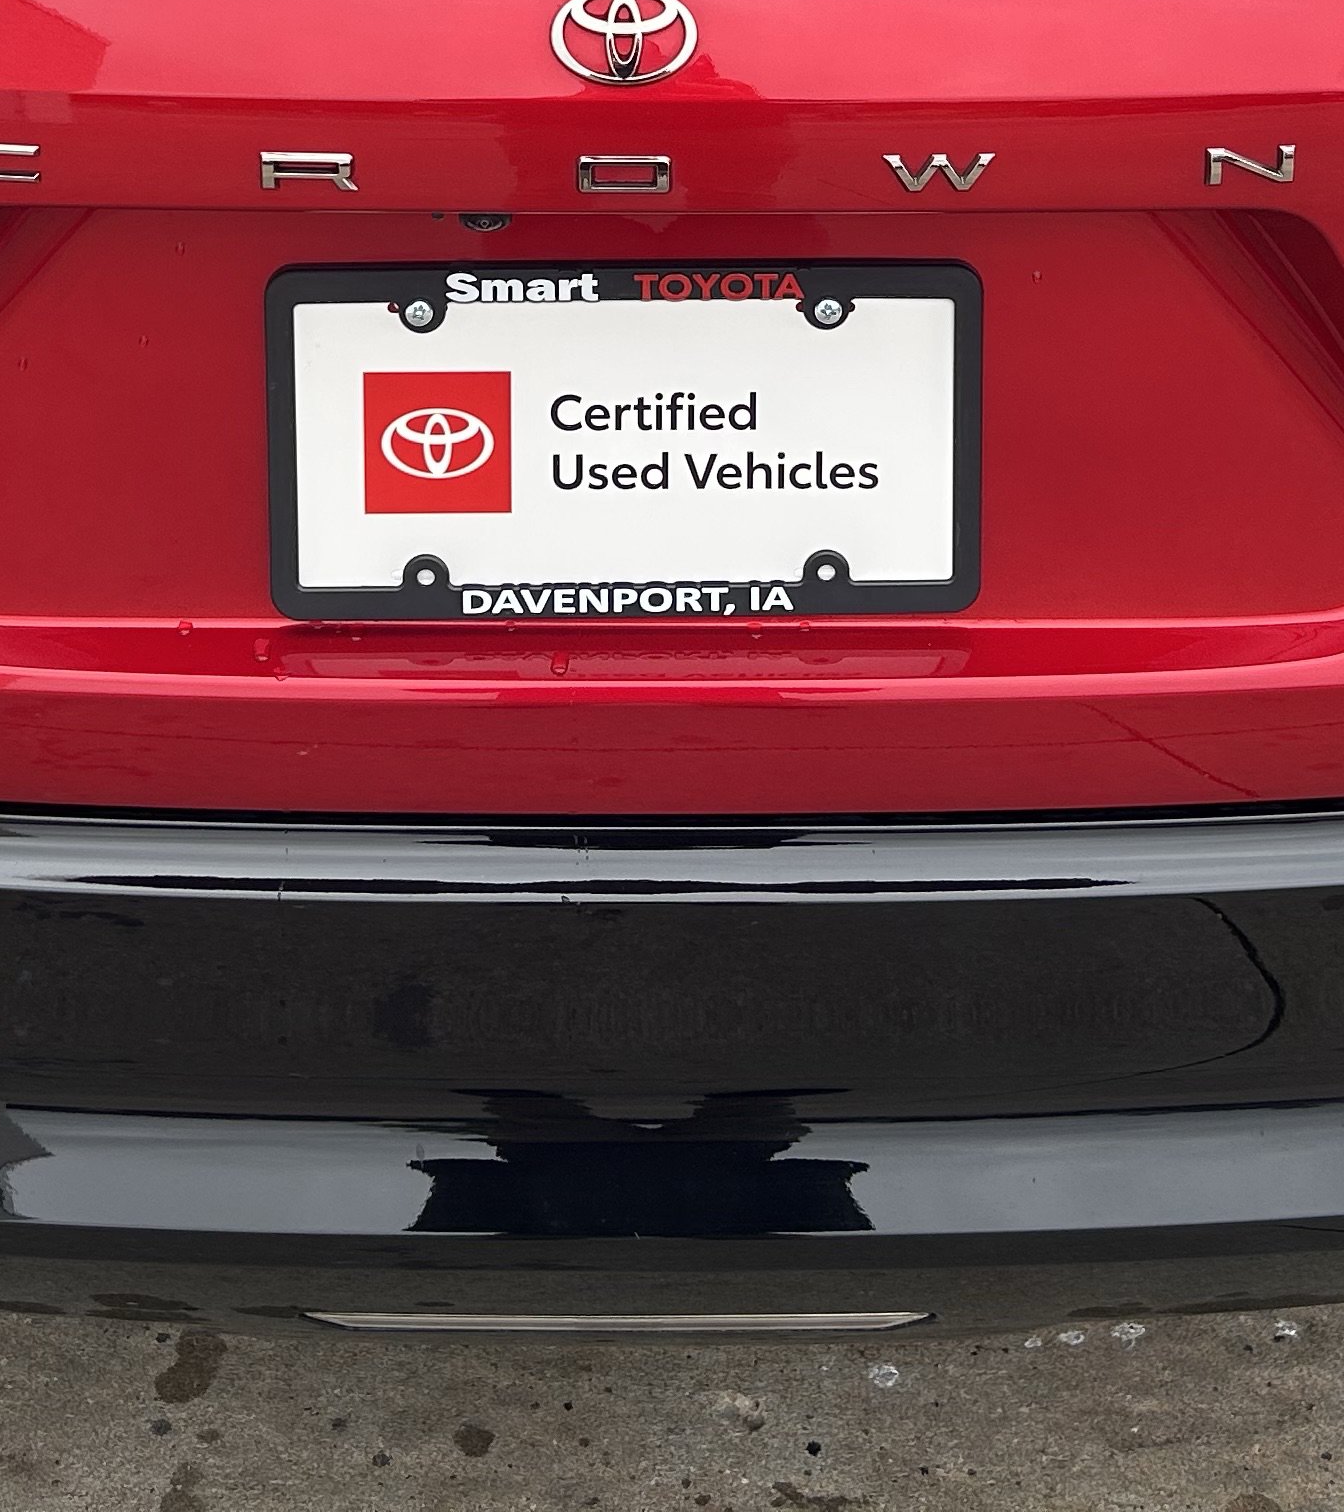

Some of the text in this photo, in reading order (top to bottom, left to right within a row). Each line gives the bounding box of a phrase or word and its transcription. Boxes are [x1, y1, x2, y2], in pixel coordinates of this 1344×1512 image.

[445, 272, 806, 303] Smart TOYOTA
[550, 392, 758, 432] Certified
[551, 452, 880, 491] Used Vehicles
[461, 585, 794, 616] DAVENPORT, IA
